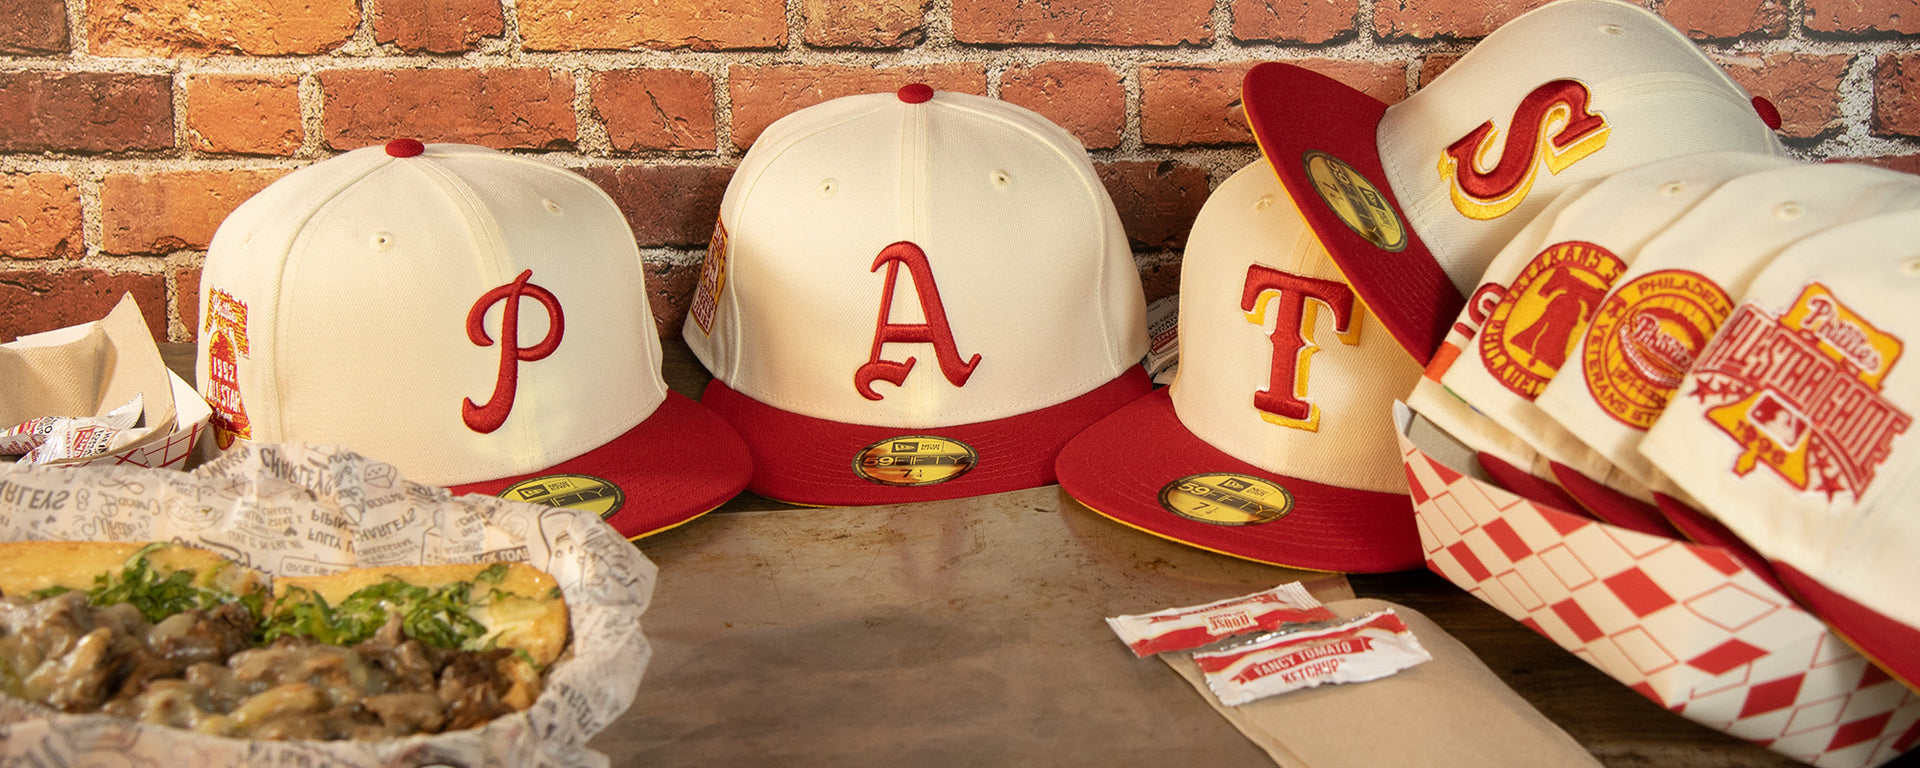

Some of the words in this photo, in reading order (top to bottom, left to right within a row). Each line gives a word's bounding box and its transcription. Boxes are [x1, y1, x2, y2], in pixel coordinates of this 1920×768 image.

[1437, 77, 1612, 220] S
[1605, 265, 1621, 284] S
[854, 240, 982, 401] A
[1638, 277, 1730, 321] PHILADELP
[462, 269, 565, 434] P
[1239, 263, 1365, 432] T
[1801, 295, 1883, 375] Phillies
[212, 355, 236, 384] 1992
[1588, 323, 1629, 415] VETERANS
[1630, 409, 1656, 425] ST
[220, 383, 242, 414] STAR
[863, 455, 966, 466] 59FIFTY
[1178, 482, 1268, 514] 59FIFTY
[1253, 656, 1296, 677] FANCY
[1297, 641, 1353, 661] TOMATO
